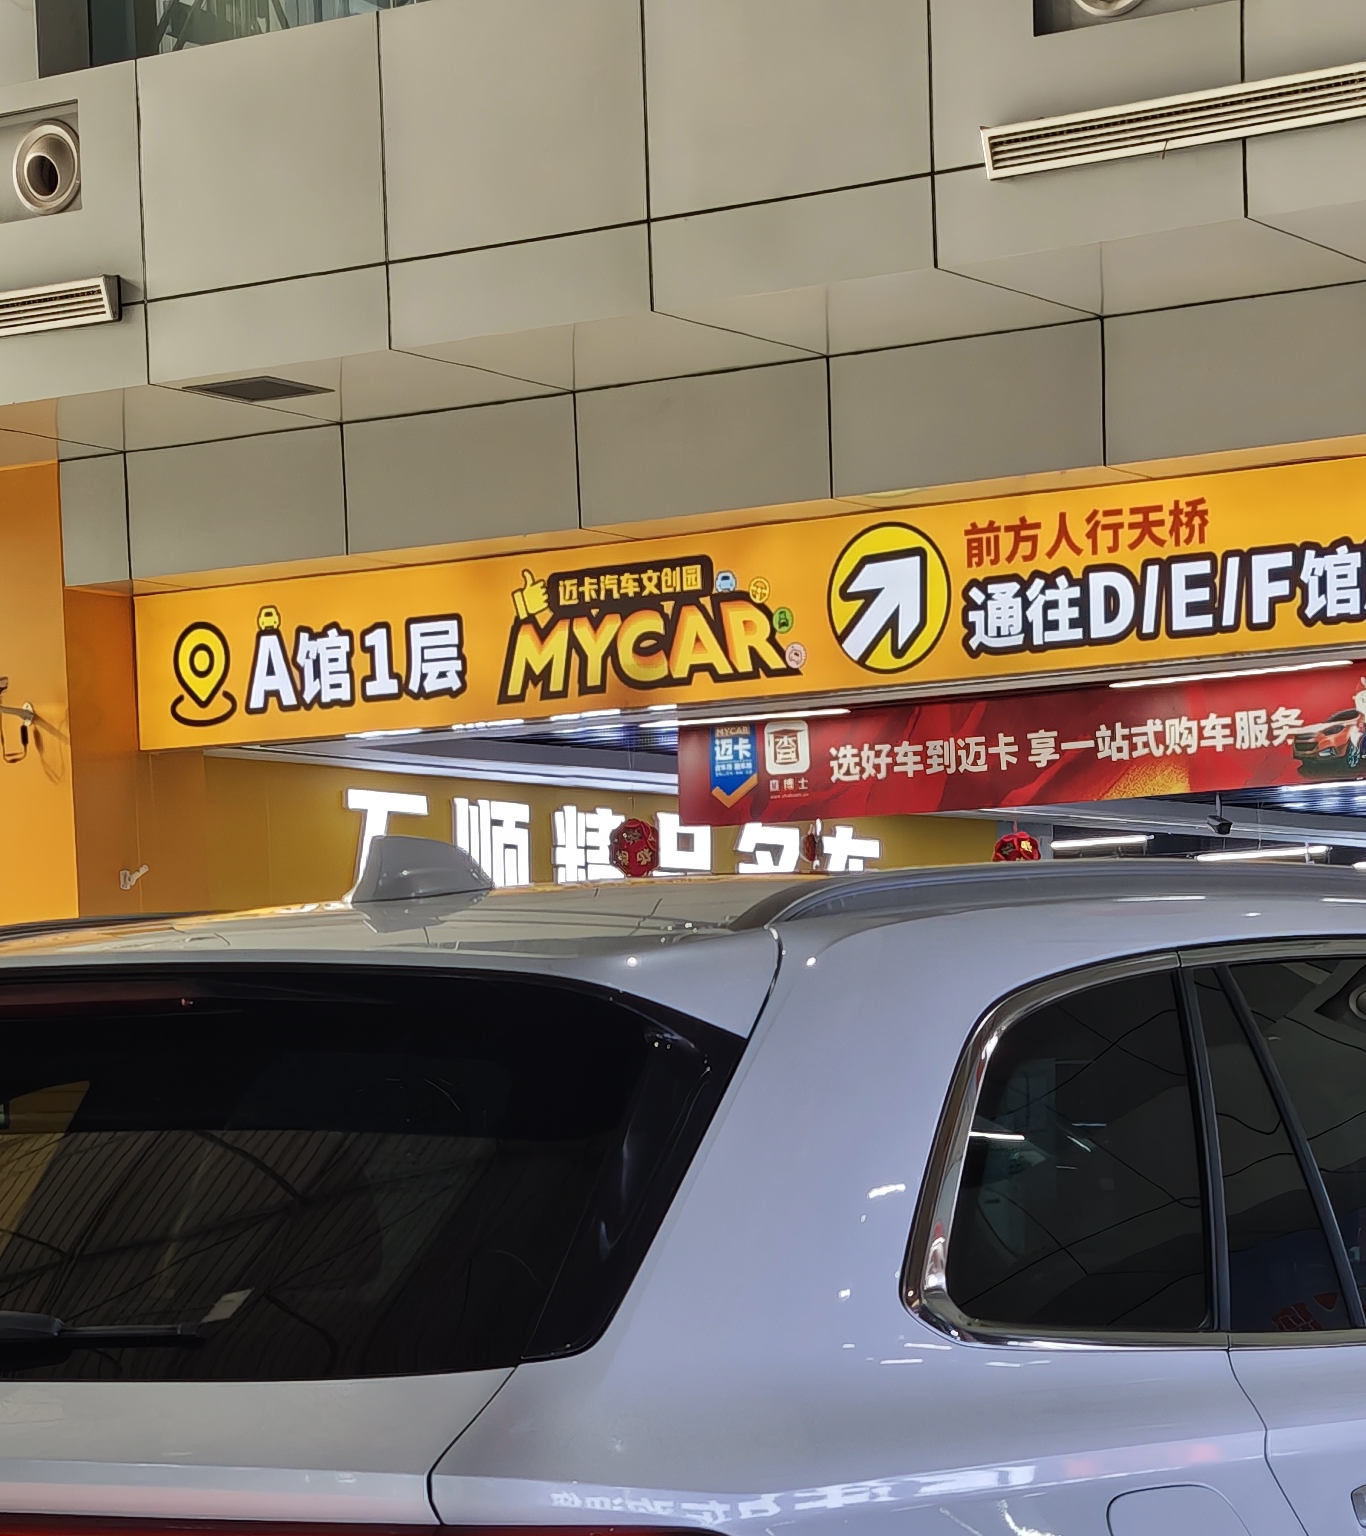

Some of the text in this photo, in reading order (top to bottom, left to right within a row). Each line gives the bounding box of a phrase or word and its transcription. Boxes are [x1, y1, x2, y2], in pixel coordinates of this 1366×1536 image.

[963, 498, 1209, 568] 前方人行天桥
[558, 564, 702, 606] 迈卡汽车文创园
[249, 619, 464, 709] A馆1层
[505, 601, 788, 697] MYCAR
[714, 738, 752, 760] 迈卡
[716, 726, 749, 736] MYCAR
[829, 706, 1309, 782] 选好车到迈卡 享一站式购车服务
